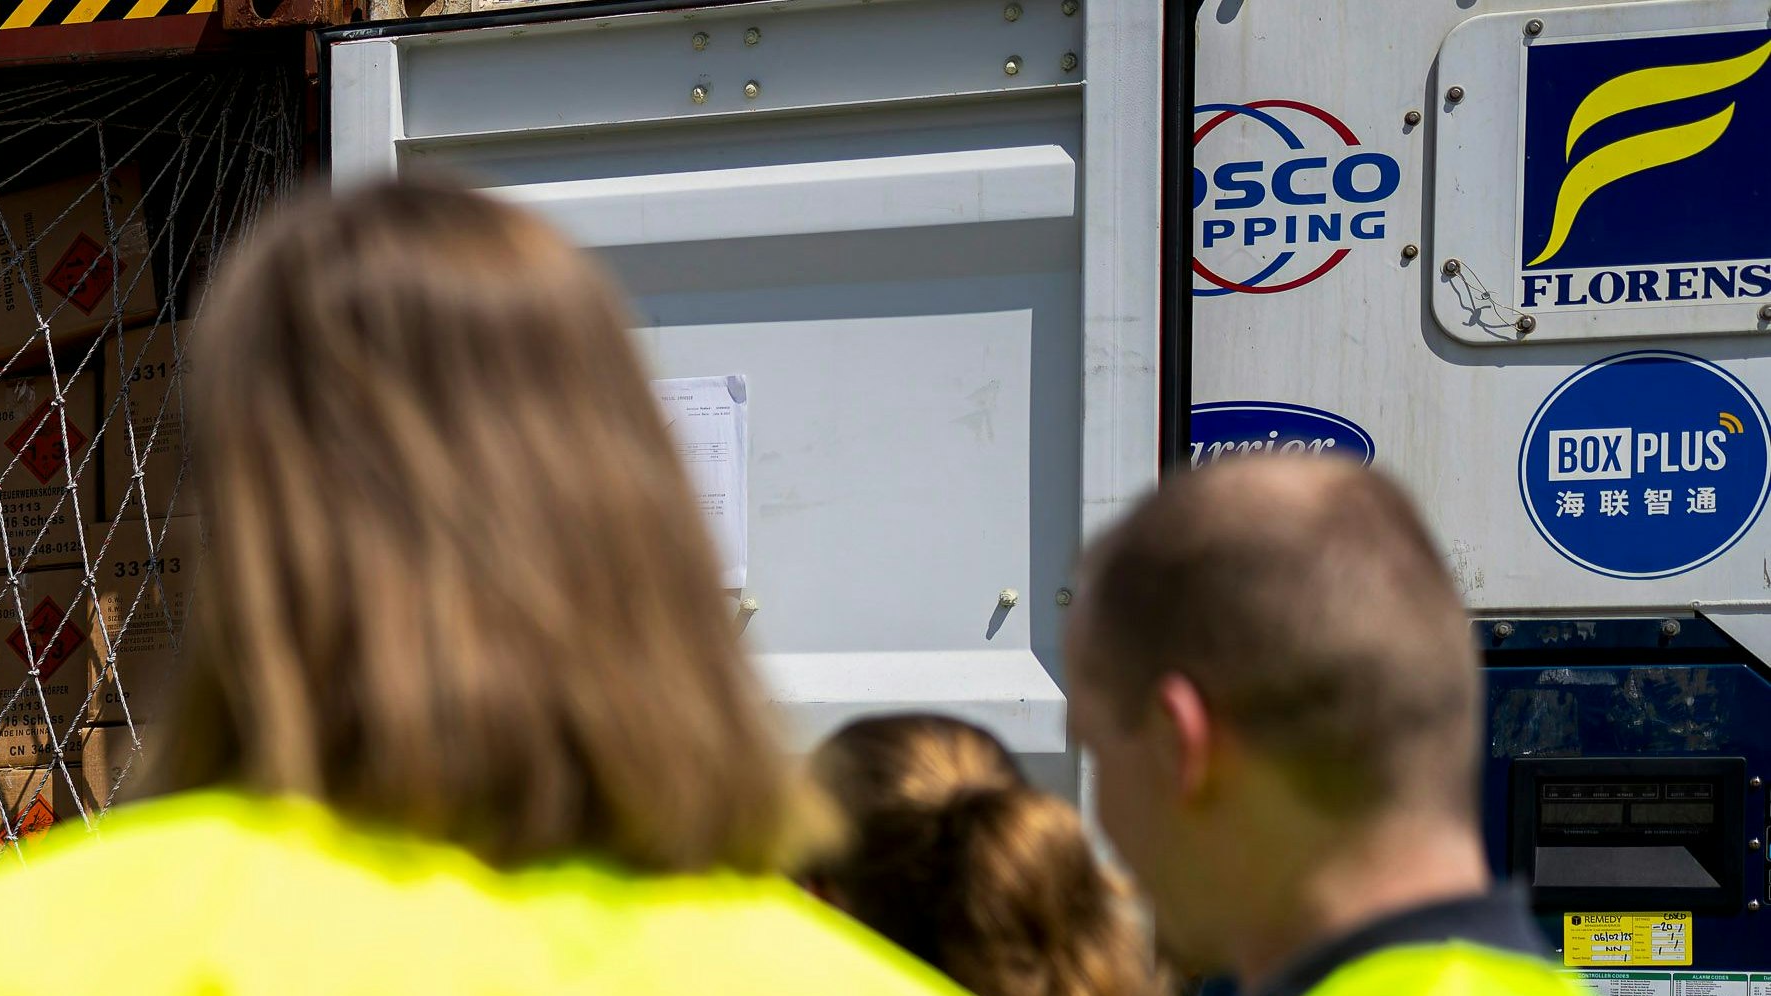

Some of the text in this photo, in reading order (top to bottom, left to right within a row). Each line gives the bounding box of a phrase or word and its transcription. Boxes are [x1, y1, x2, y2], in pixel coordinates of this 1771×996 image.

[1193, 152, 1401, 210] SCO
[1202, 210, 1386, 249] PPING
[1521, 264, 1771, 307] FLORENS
[1558, 429, 1727, 474] BOX PLUS
[1, 502, 41, 514] 33113
[1555, 487, 1717, 518] 海联智通
[9, 746, 25, 757] CN
[1584, 915, 1622, 924] REMEDY
